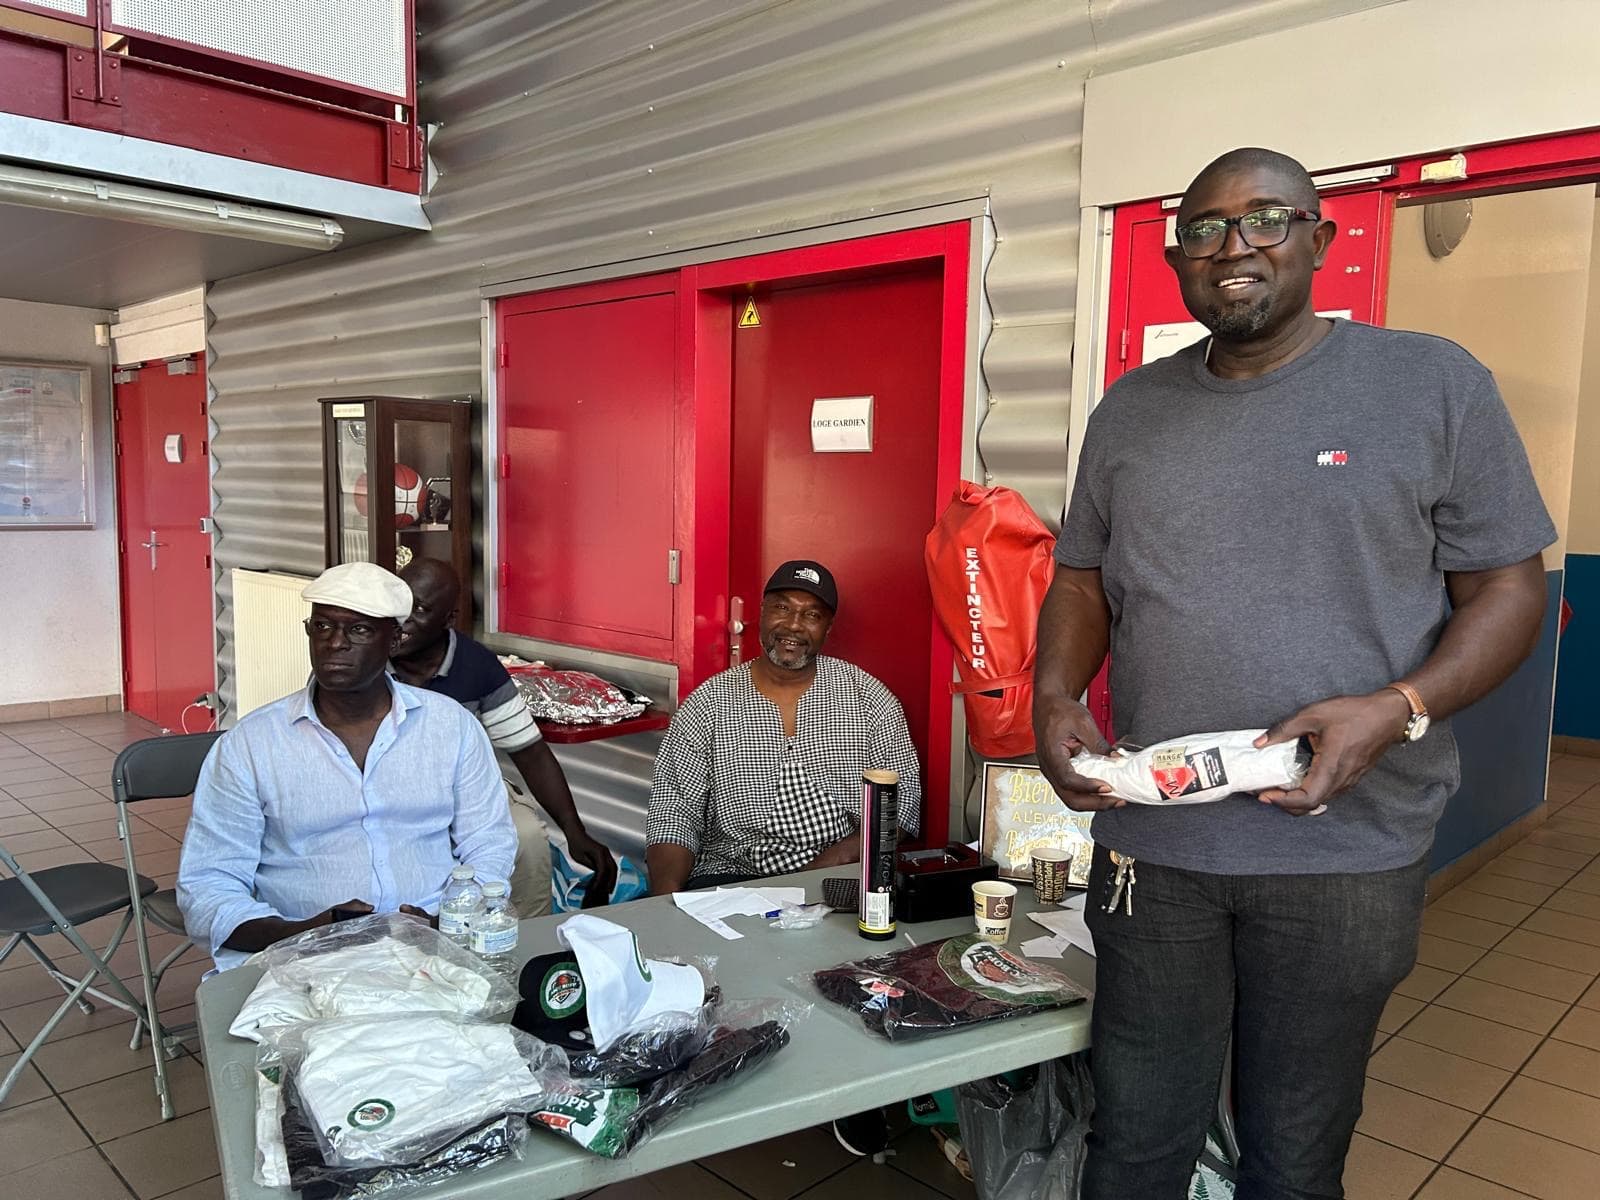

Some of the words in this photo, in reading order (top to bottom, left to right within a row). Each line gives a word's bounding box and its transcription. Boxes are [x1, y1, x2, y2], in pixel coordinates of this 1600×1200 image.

[812, 419, 832, 429] LOGE
[833, 418, 866, 428] GARDIEN
[965, 547, 986, 669] EXTINCTEUR
[1008, 772, 1058, 806] Bien
[985, 927, 1006, 936] Coffee
